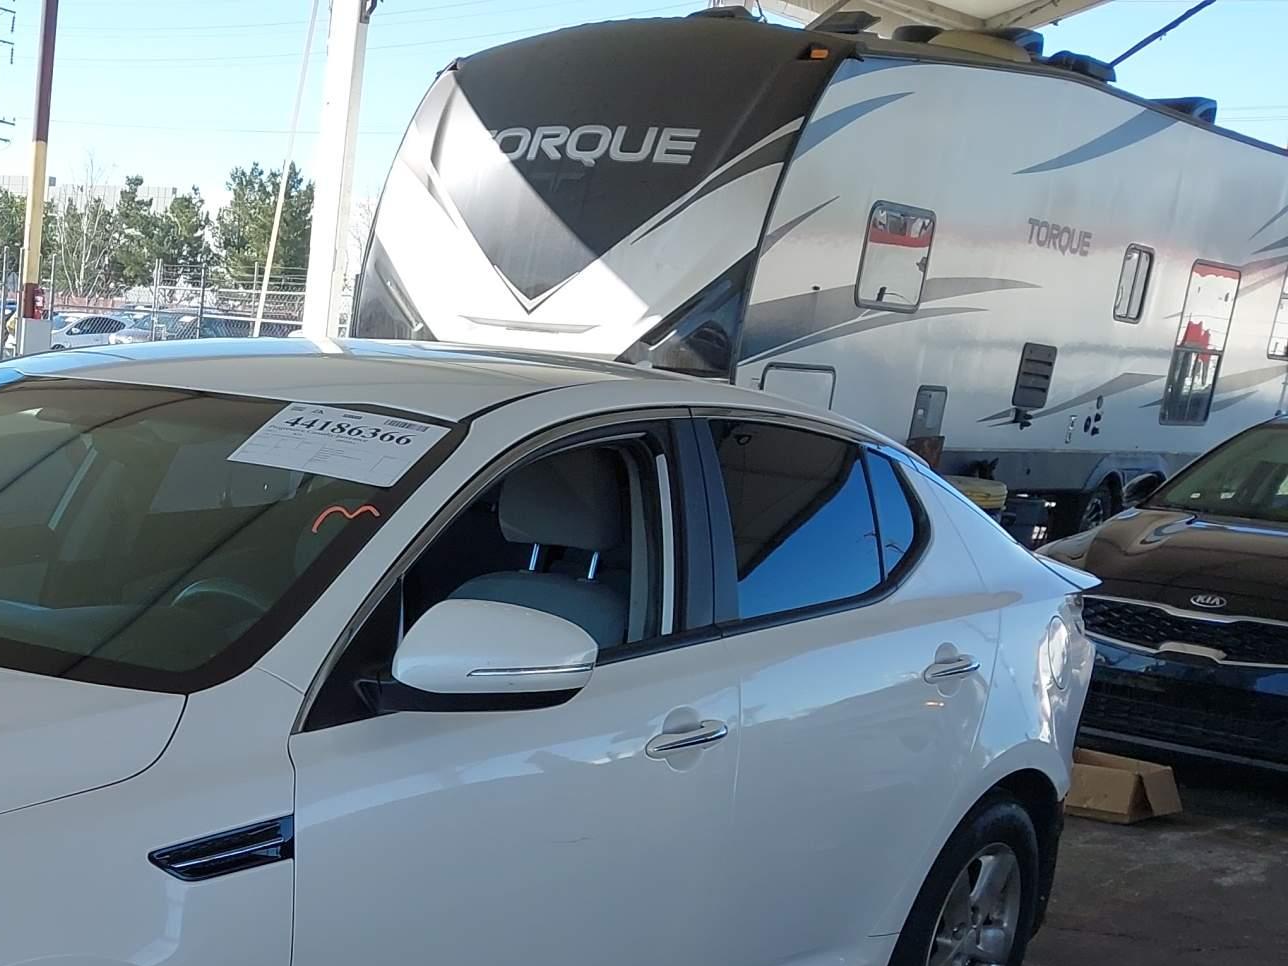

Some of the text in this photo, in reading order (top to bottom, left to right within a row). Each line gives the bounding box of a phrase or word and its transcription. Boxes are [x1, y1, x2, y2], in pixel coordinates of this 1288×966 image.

[490, 125, 701, 167] ORQUE
[1027, 217, 1093, 257] TORQUE
[284, 416, 417, 446] 44186366
